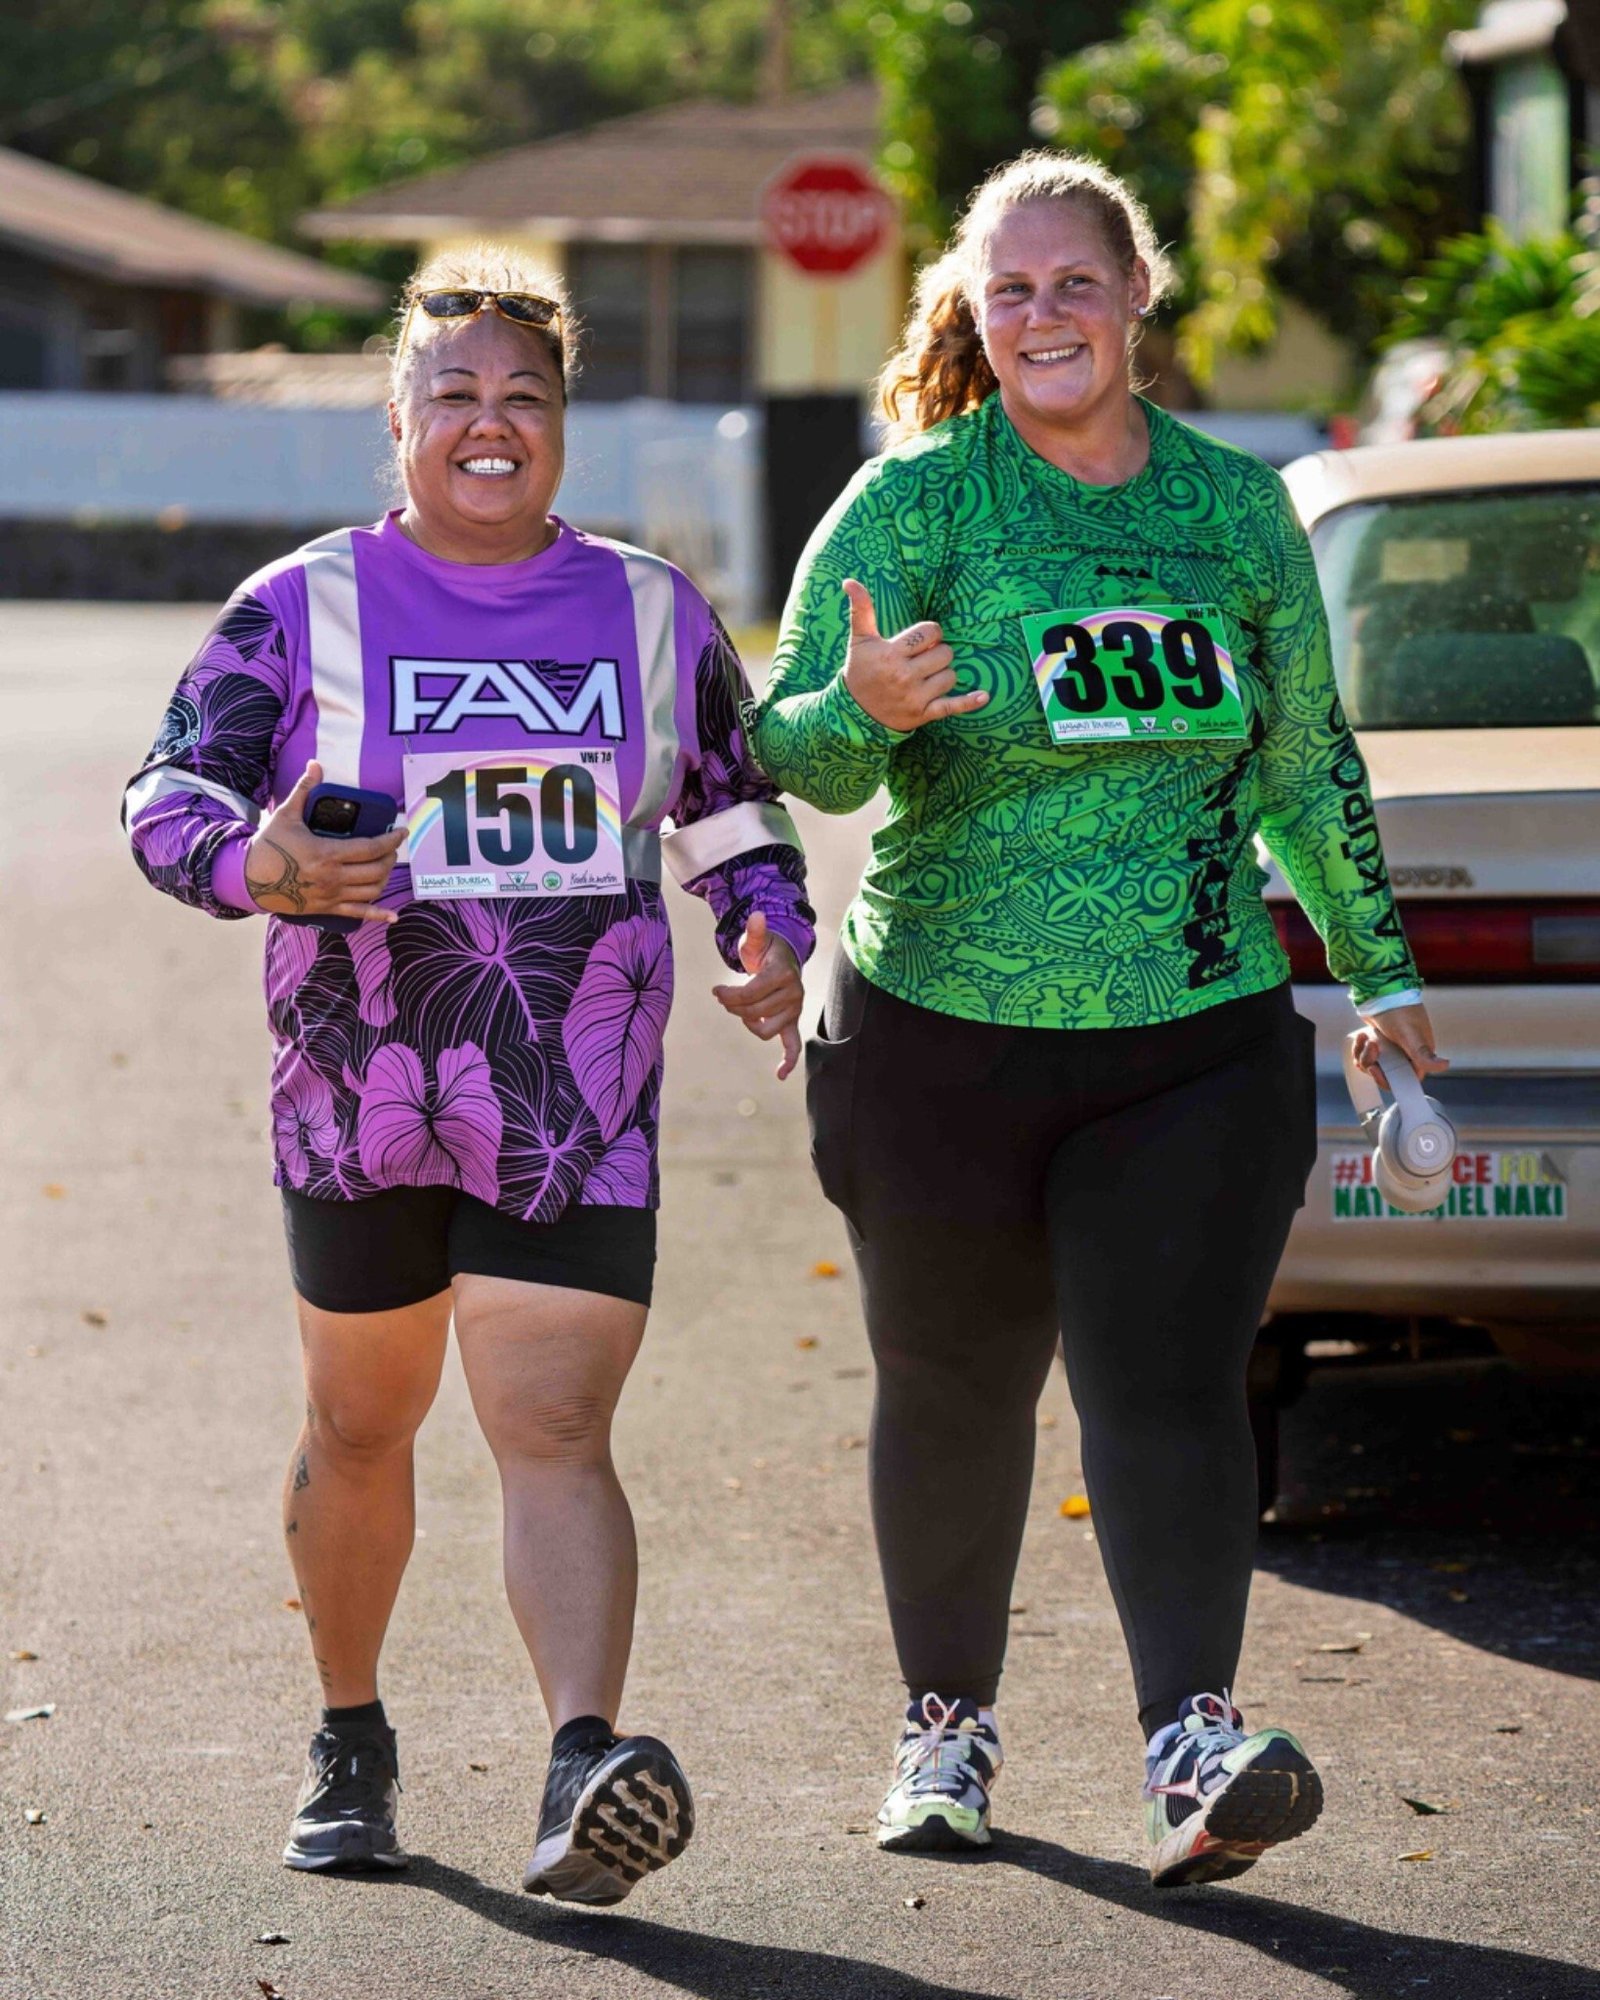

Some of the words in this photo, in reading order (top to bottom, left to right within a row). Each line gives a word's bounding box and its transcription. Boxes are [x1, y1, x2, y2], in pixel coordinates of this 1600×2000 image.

[776, 191, 884, 243] STOP
[389, 656, 626, 741] FAM
[1042, 619, 1224, 713] 339
[426, 764, 598, 867] 150
[1333, 1185, 1489, 1217] NATIEL
[1494, 1184, 1564, 1217] NAKI
[1500, 1153, 1563, 1184] FO
